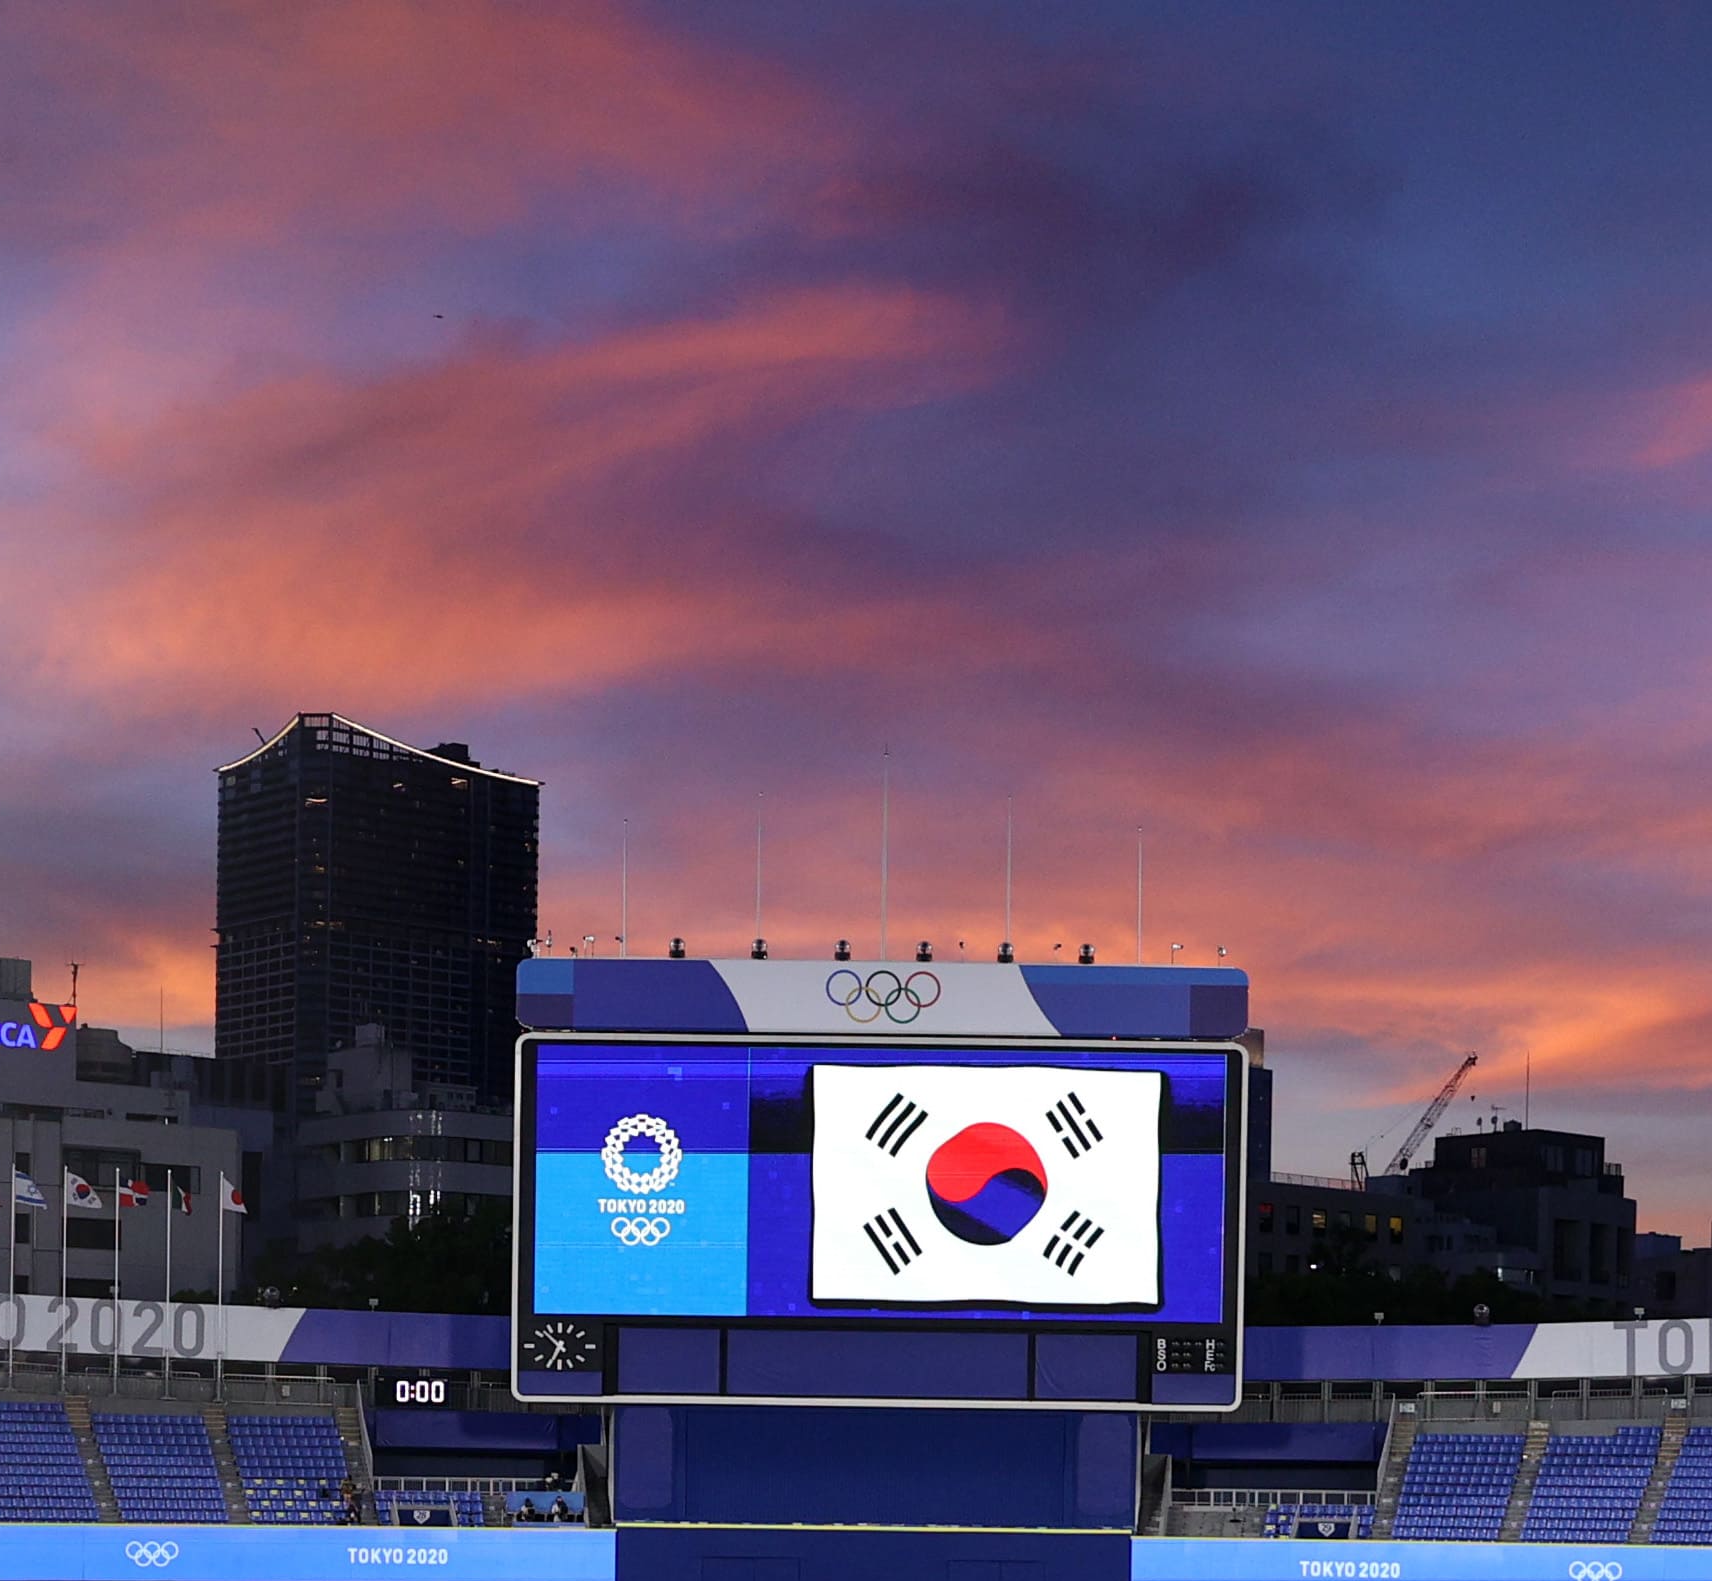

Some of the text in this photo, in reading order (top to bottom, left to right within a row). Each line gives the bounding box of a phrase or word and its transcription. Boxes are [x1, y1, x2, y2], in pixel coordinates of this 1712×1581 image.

[597, 1198, 685, 1214] TOKYO 2020
[46, 1296, 206, 1358] 2020
[1156, 1338, 1166, 1350] B
[1206, 1338, 1215, 1350] H
[1157, 1350, 1166, 1360] S
[1206, 1350, 1214, 1361] E
[1156, 1360, 1166, 1372] O
[396, 1380, 444, 1402] 0:00
[348, 1548, 448, 1564] TOKYO 2020
[1300, 1561, 1400, 1578] TOKYO 2020
